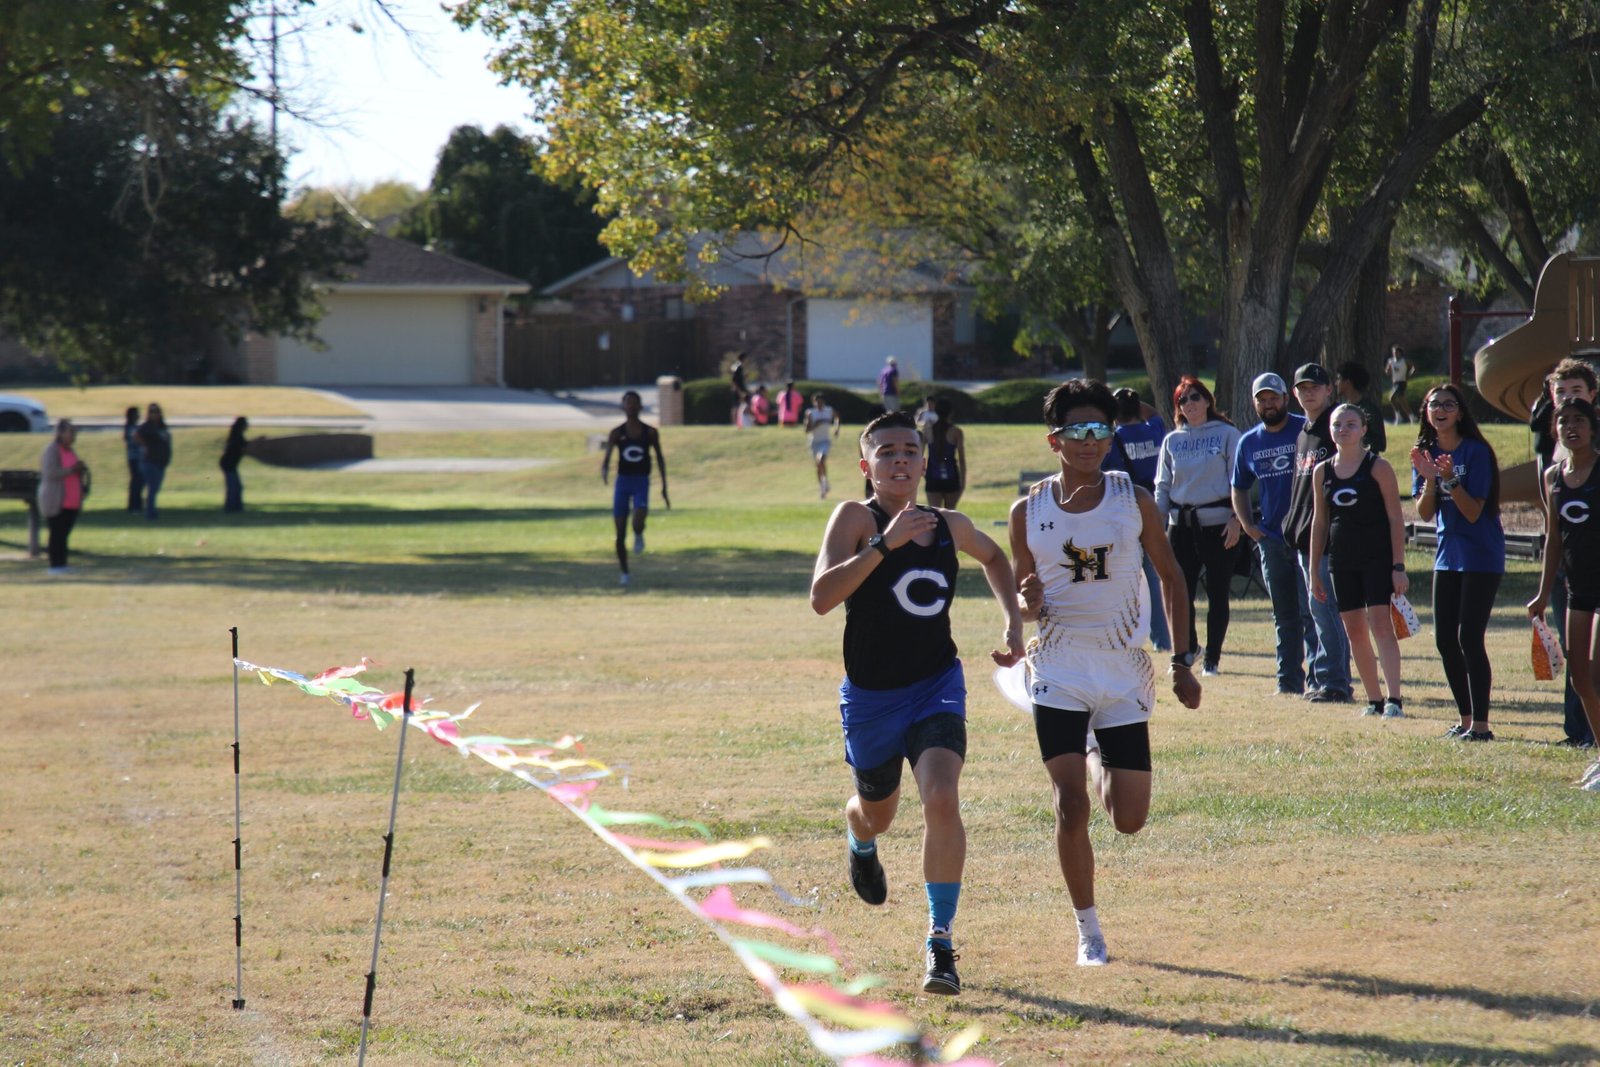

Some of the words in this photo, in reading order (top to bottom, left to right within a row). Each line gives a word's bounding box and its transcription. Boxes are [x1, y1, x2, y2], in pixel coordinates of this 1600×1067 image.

[1174, 434, 1222, 452] CAVEMEN
[622, 446, 644, 462] C
[1252, 444, 1296, 461] CARLSBAD
[1332, 488, 1358, 506] C
[1560, 500, 1590, 523] C
[1068, 543, 1113, 583] H
[891, 568, 949, 617] C
